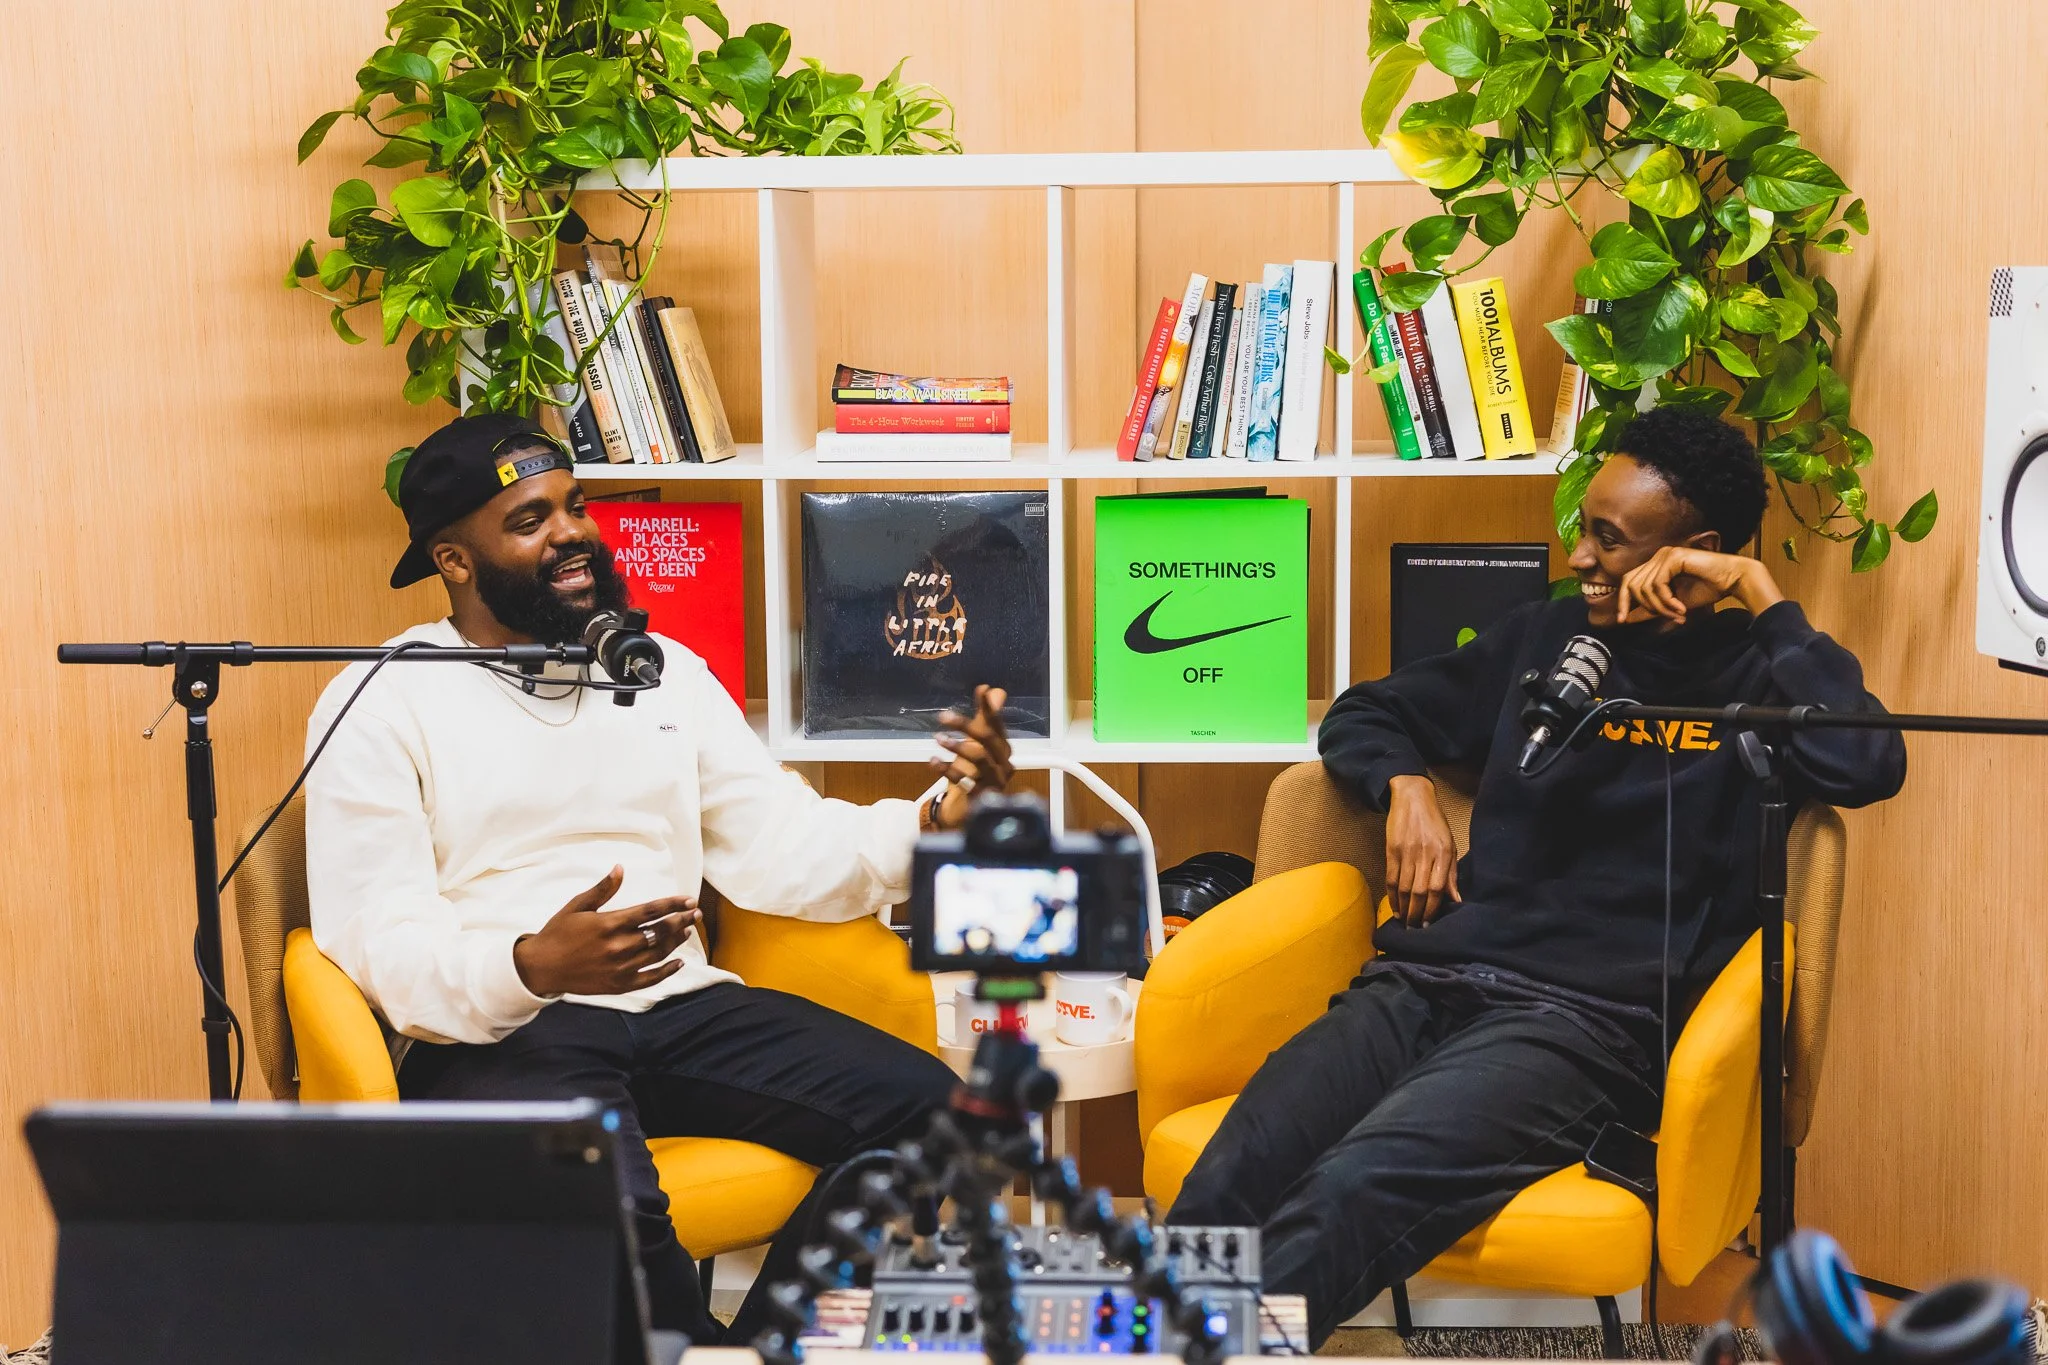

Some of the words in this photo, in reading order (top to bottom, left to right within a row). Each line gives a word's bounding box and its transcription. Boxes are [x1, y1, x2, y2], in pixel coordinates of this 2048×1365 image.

[559, 279, 574, 297] HOW
[567, 300, 580, 317] THE
[1218, 294, 1228, 310] This
[1305, 298, 1313, 320] Steve
[1214, 312, 1225, 333] Here
[1474, 307, 1483, 326] MUST
[573, 318, 588, 344] WORD
[1156, 327, 1169, 352] SISTER
[1367, 303, 1377, 317] Do
[1379, 345, 1390, 364] Fas
[1391, 331, 1400, 345] WAR
[1478, 326, 1486, 344] HEAR
[1210, 334, 1221, 357] Flesh
[1403, 311, 1421, 351] ATIVITY,
[1412, 351, 1426, 373] INC.
[1227, 342, 1238, 374] WALKER
[1395, 349, 1404, 359] ART
[1481, 344, 1490, 368] BEFORE
[1145, 354, 1160, 388] OUTSIDER
[1205, 365, 1215, 384] Cole
[1422, 374, 1429, 382] ED
[876, 389, 911, 400] BLACK
[1223, 374, 1232, 405] BANNED
[1241, 376, 1249, 396] YOUR
[1201, 386, 1213, 413] Arthur
[1425, 384, 1437, 412] CATMULL
[573, 416, 584, 438] LAND
[850, 417, 866, 425] The
[869, 417, 899, 426] 4-Hour
[901, 417, 945, 426] Workweek
[1196, 414, 1208, 434] Riley
[1237, 414, 1245, 436] THING
[605, 429, 619, 437] CLINT
[606, 436, 622, 444] SMITH
[620, 518, 700, 532] PHARRELL:
[632, 533, 688, 547] PLACES
[614, 549, 649, 562] AND
[652, 548, 706, 562] SPACES
[626, 563, 654, 577] I'VE
[659, 563, 696, 577] BEEN
[904, 571, 952, 586] FIRE
[1129, 562, 1276, 579] SOMETHING'S
[917, 594, 939, 608] IN
[888, 616, 967, 634] LITTLE
[894, 640, 963, 656] AFRICA
[1183, 667, 1223, 684] OFF
